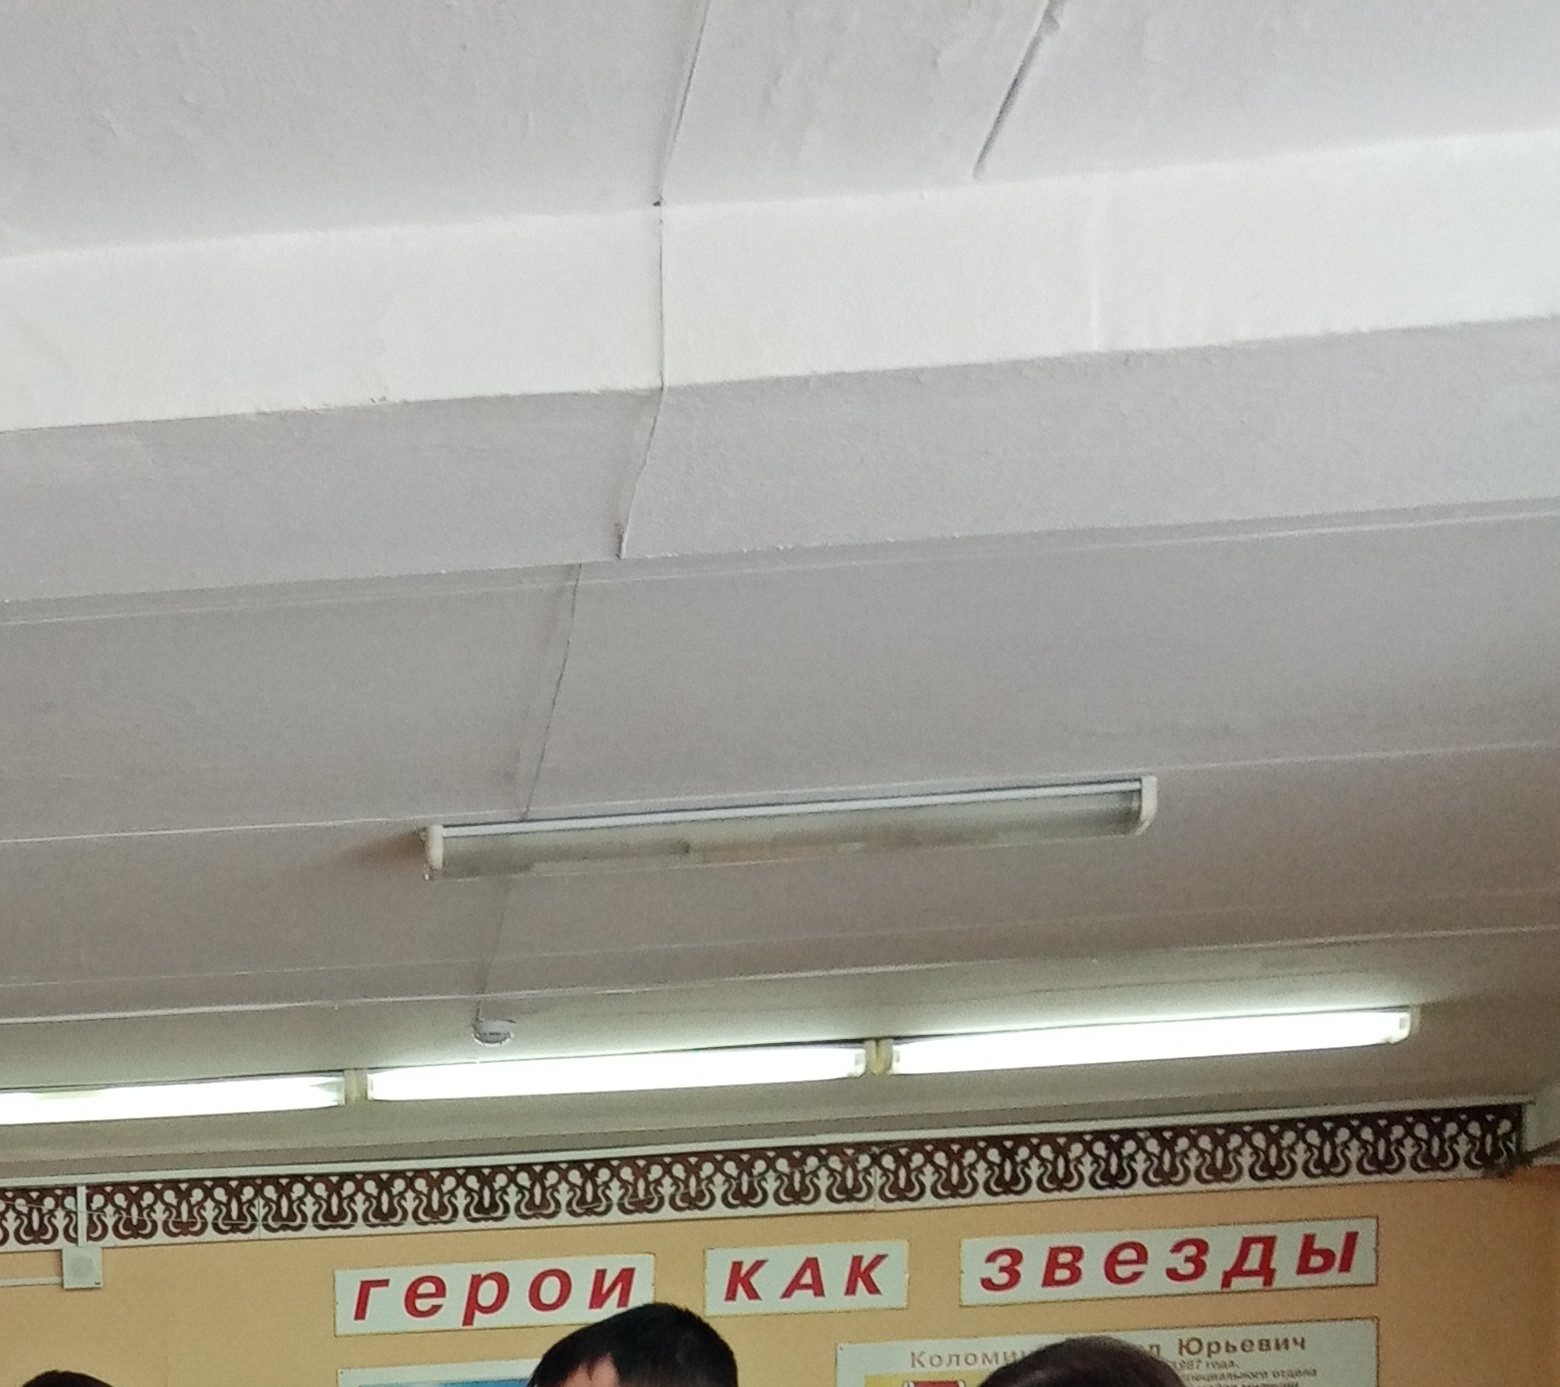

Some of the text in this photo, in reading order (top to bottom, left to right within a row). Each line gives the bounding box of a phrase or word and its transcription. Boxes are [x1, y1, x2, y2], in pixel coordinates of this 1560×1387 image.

[352, 1266, 636, 1328] герои
[979, 1230, 1360, 1293] звезды
[1177, 1335, 1307, 1358] Юрьевич
